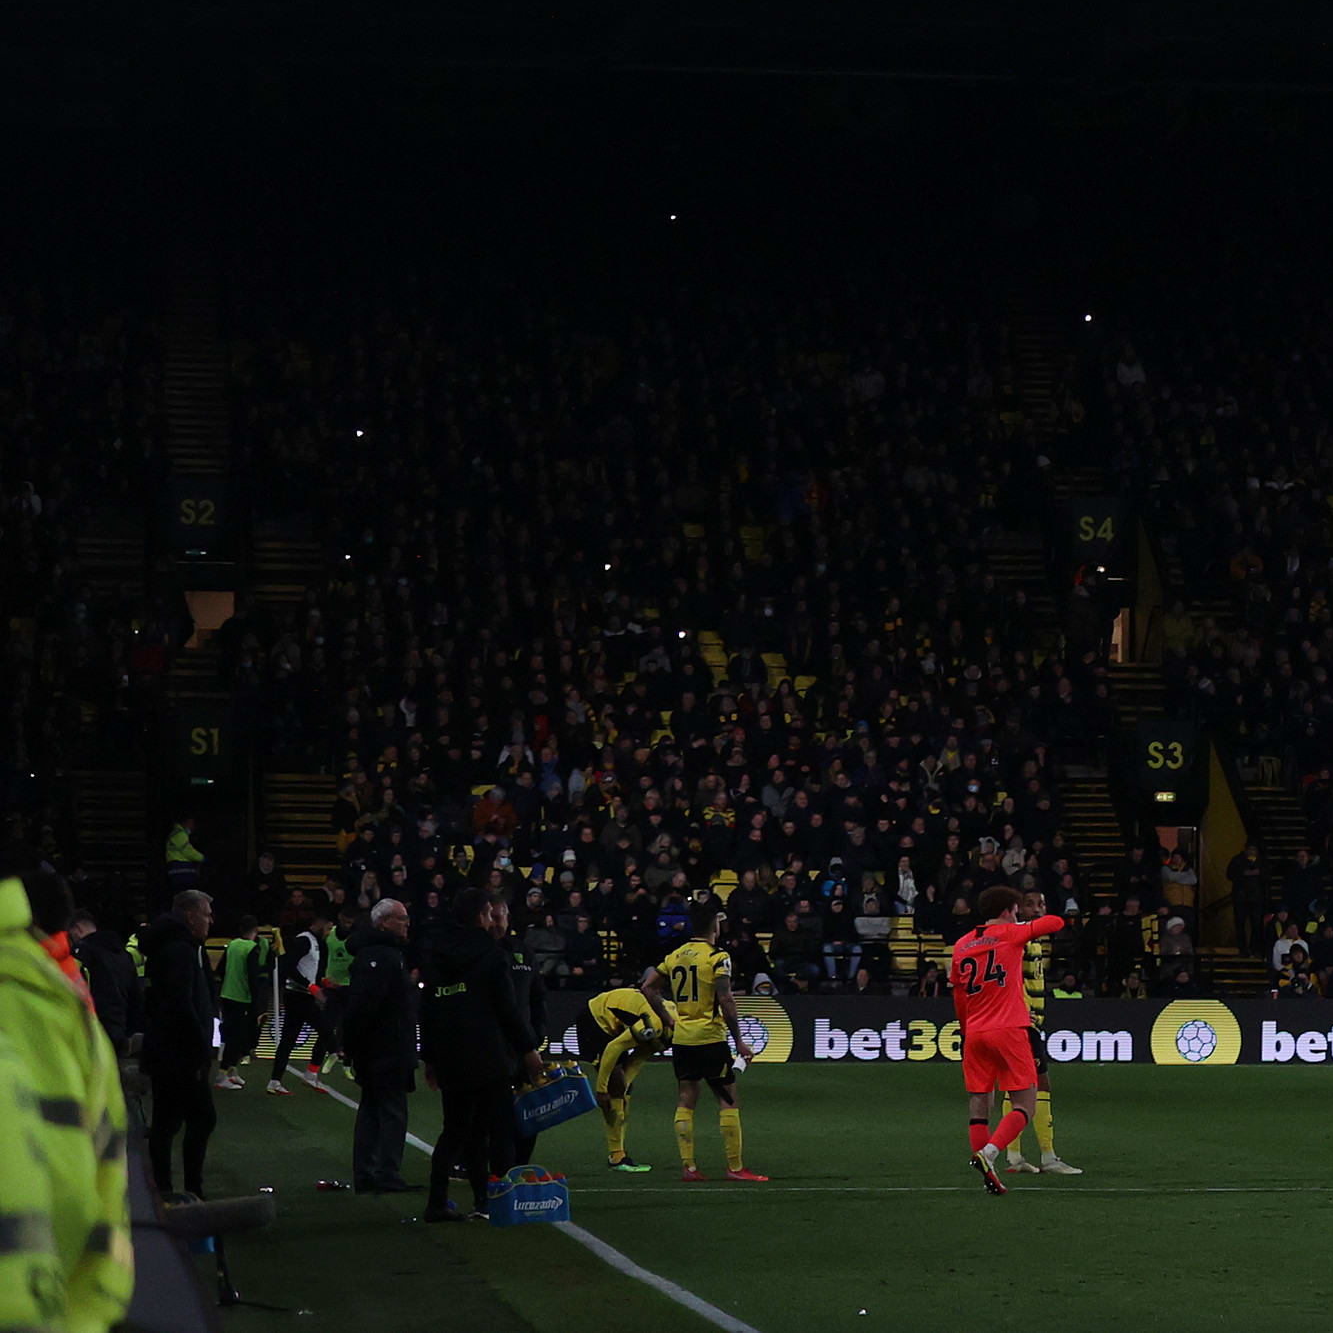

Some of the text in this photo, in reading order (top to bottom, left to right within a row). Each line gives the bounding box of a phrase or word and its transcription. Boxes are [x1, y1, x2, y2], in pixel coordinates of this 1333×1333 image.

[180, 499, 216, 525] S2
[1079, 516, 1115, 542] S4
[189, 727, 221, 755] S1
[1147, 741, 1184, 770] S3
[672, 965, 698, 1001] 21
[960, 948, 1006, 994] 24
